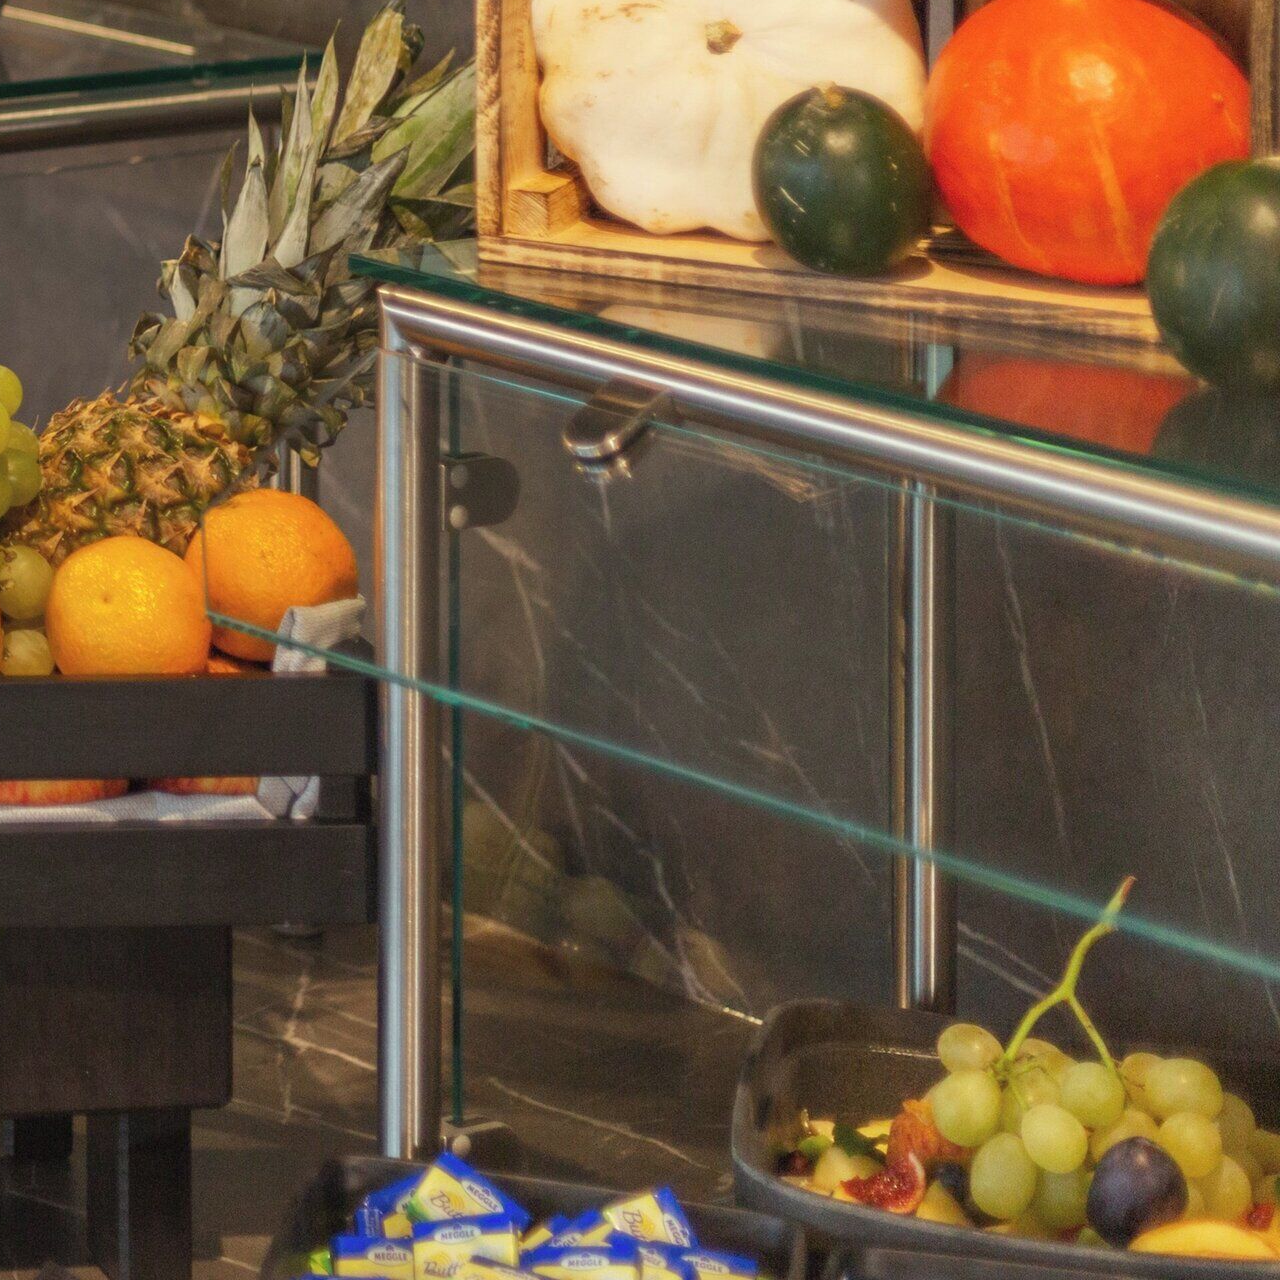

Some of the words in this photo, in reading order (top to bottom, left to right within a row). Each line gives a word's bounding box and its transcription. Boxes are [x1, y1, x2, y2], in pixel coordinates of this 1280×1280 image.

[466, 1182, 500, 1213] MEGGLE
[440, 1228, 475, 1241] MEGGLE
[374, 1251, 408, 1262] MEGGLE
[568, 1258, 603, 1268] MEGGLE
[693, 1261, 724, 1274] EGGLE
